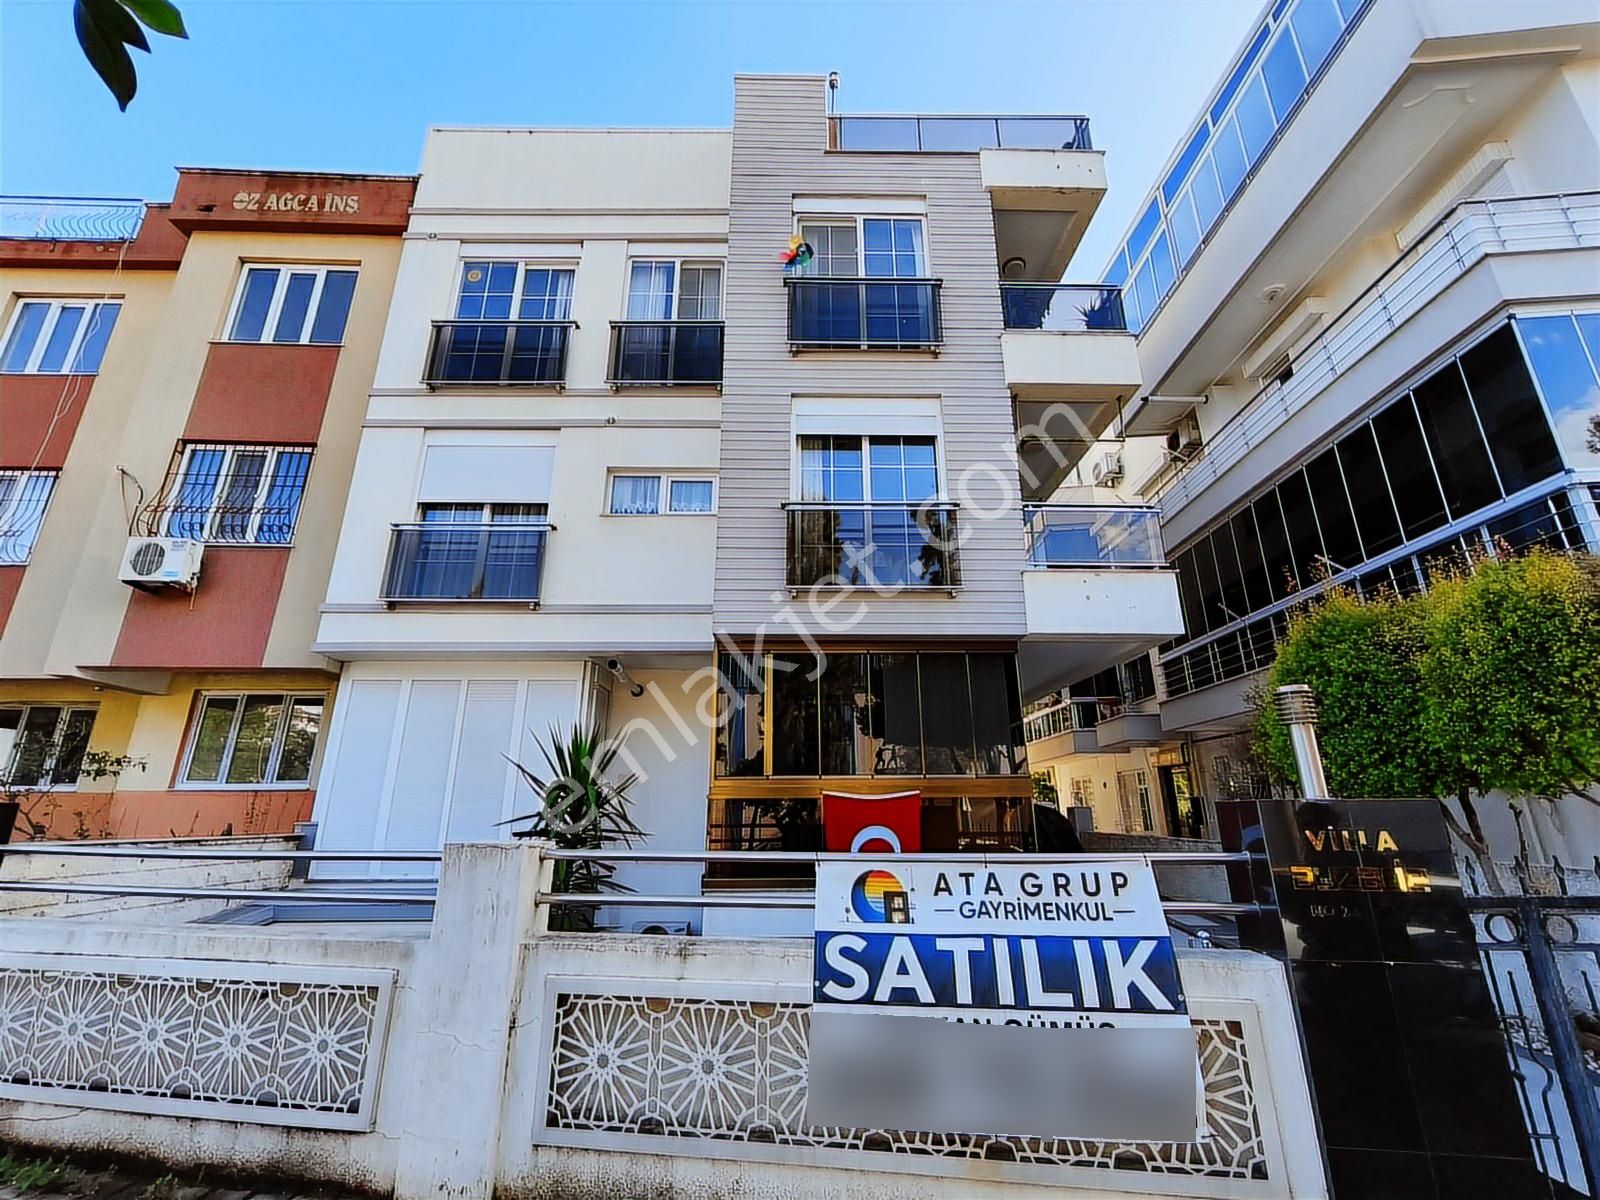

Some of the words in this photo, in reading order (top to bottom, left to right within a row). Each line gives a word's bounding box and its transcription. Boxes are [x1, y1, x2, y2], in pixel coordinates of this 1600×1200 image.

[933, 872, 1000, 897] ATA
[1019, 872, 1129, 898] GRUP
[822, 934, 1175, 1011] SATILIK
